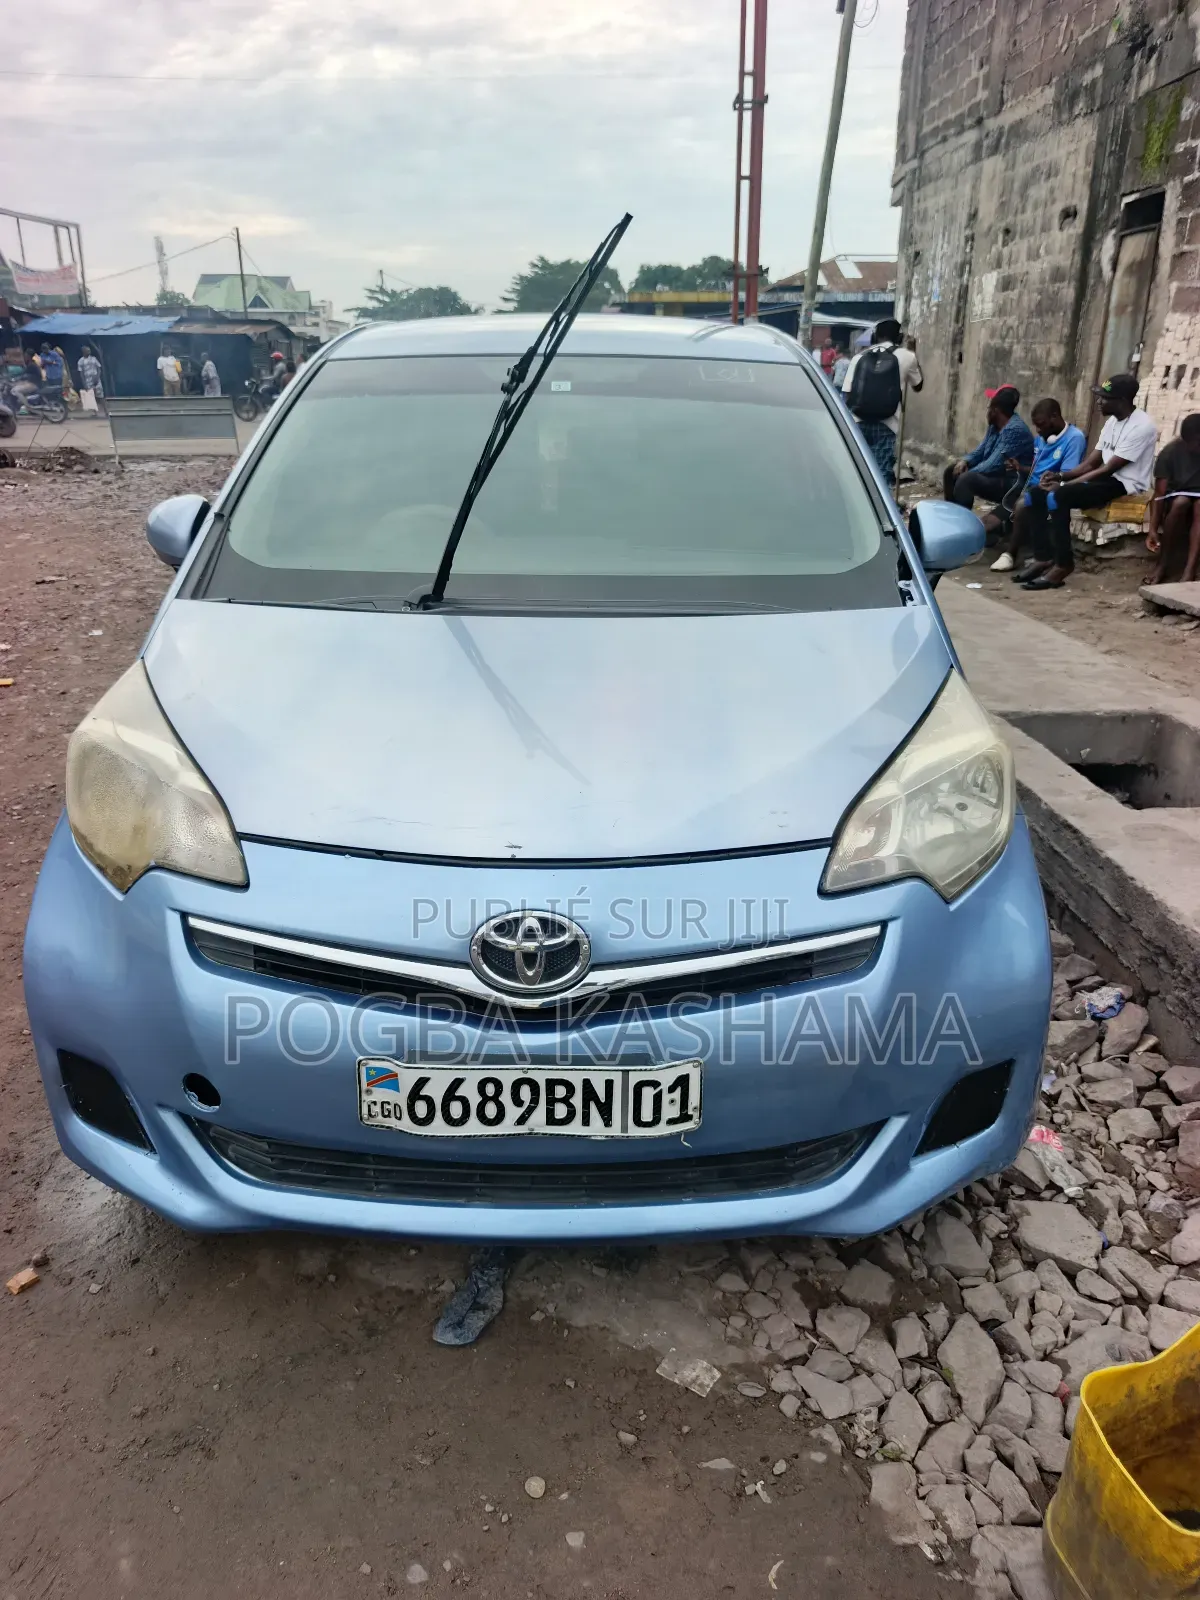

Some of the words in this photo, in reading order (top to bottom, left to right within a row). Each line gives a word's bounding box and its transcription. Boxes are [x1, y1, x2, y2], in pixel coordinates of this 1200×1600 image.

[366, 1100, 403, 1120] CGO
[407, 1076, 614, 1127] 6689BN
[632, 1073, 694, 1128] 01
